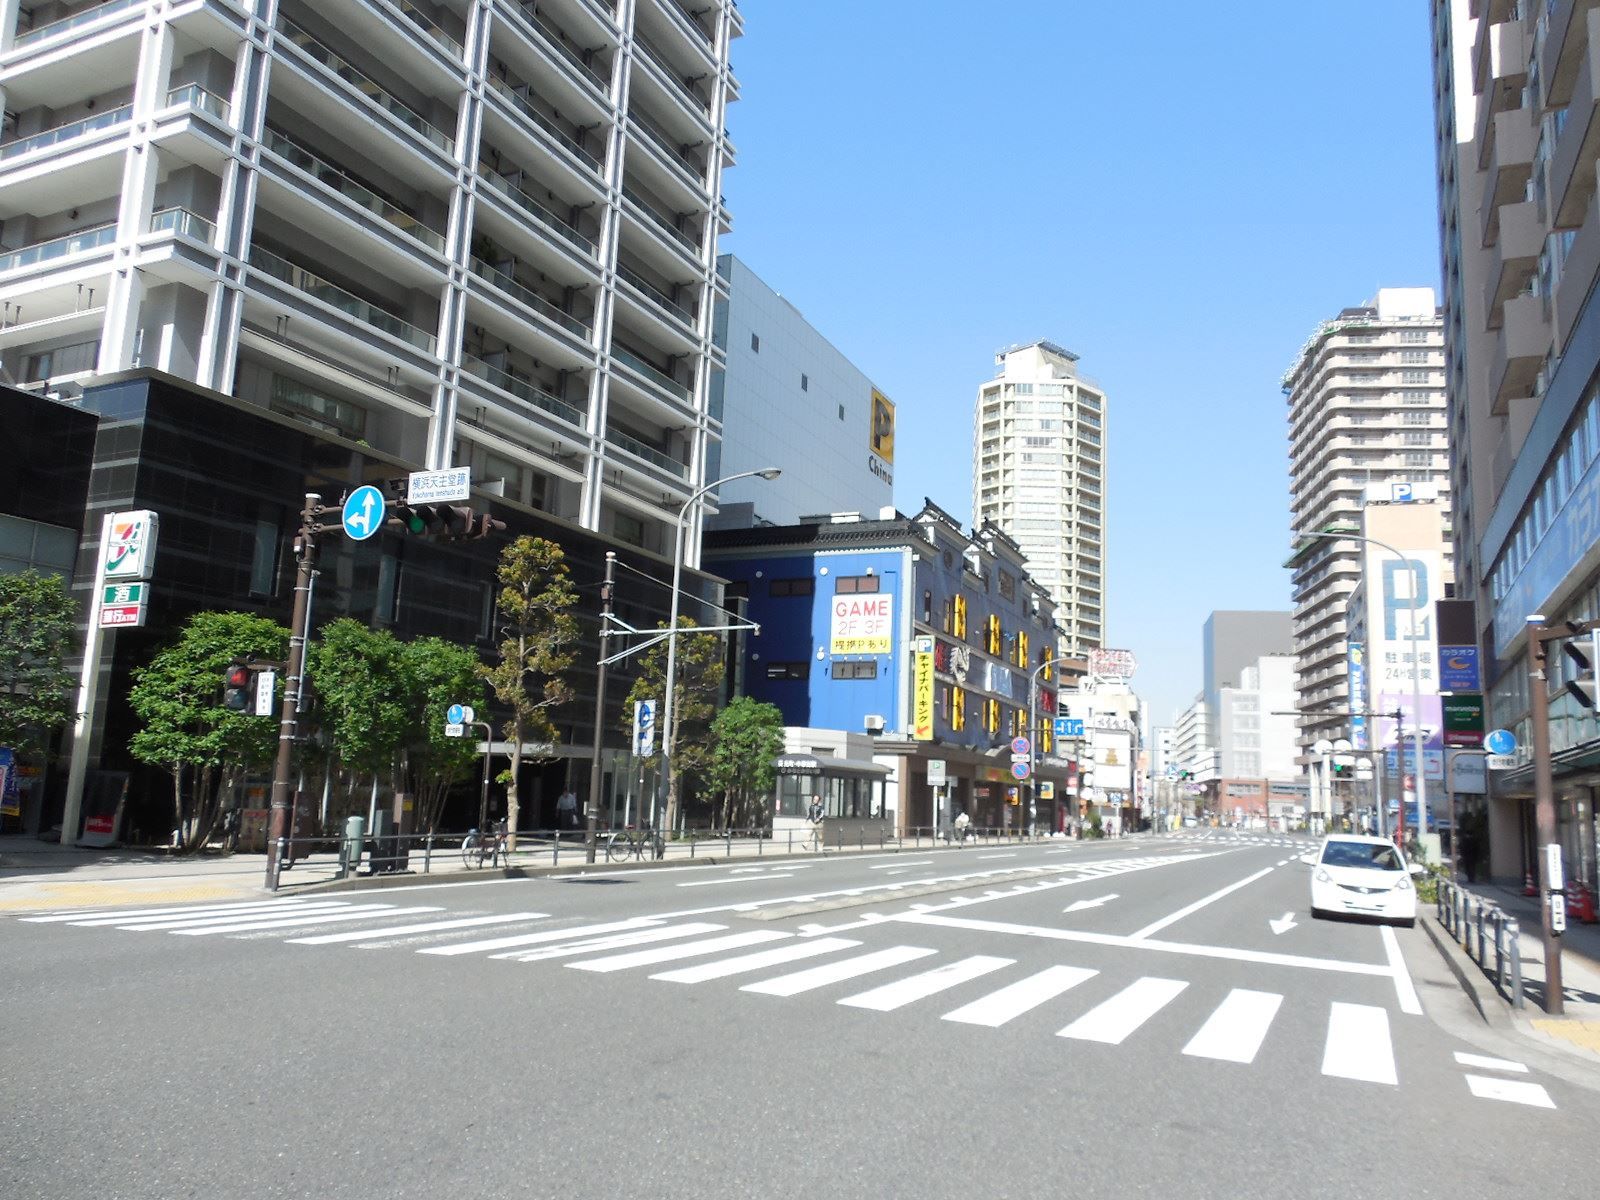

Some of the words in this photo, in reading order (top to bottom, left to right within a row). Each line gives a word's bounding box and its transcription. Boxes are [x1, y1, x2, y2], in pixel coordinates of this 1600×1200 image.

[874, 398, 891, 450] P
[869, 454, 893, 486] China
[412, 473, 466, 489] 横浜天主堂跡
[1393, 484, 1411, 500] P
[113, 585, 132, 603] 酒
[1382, 559, 1429, 641] P
[835, 600, 889, 618] GAME
[838, 620, 857, 637] 2F
[864, 619, 885, 635] 3F
[1385, 651, 1432, 665] 駐車場
[919, 654, 929, 723] チャイナパーキング
